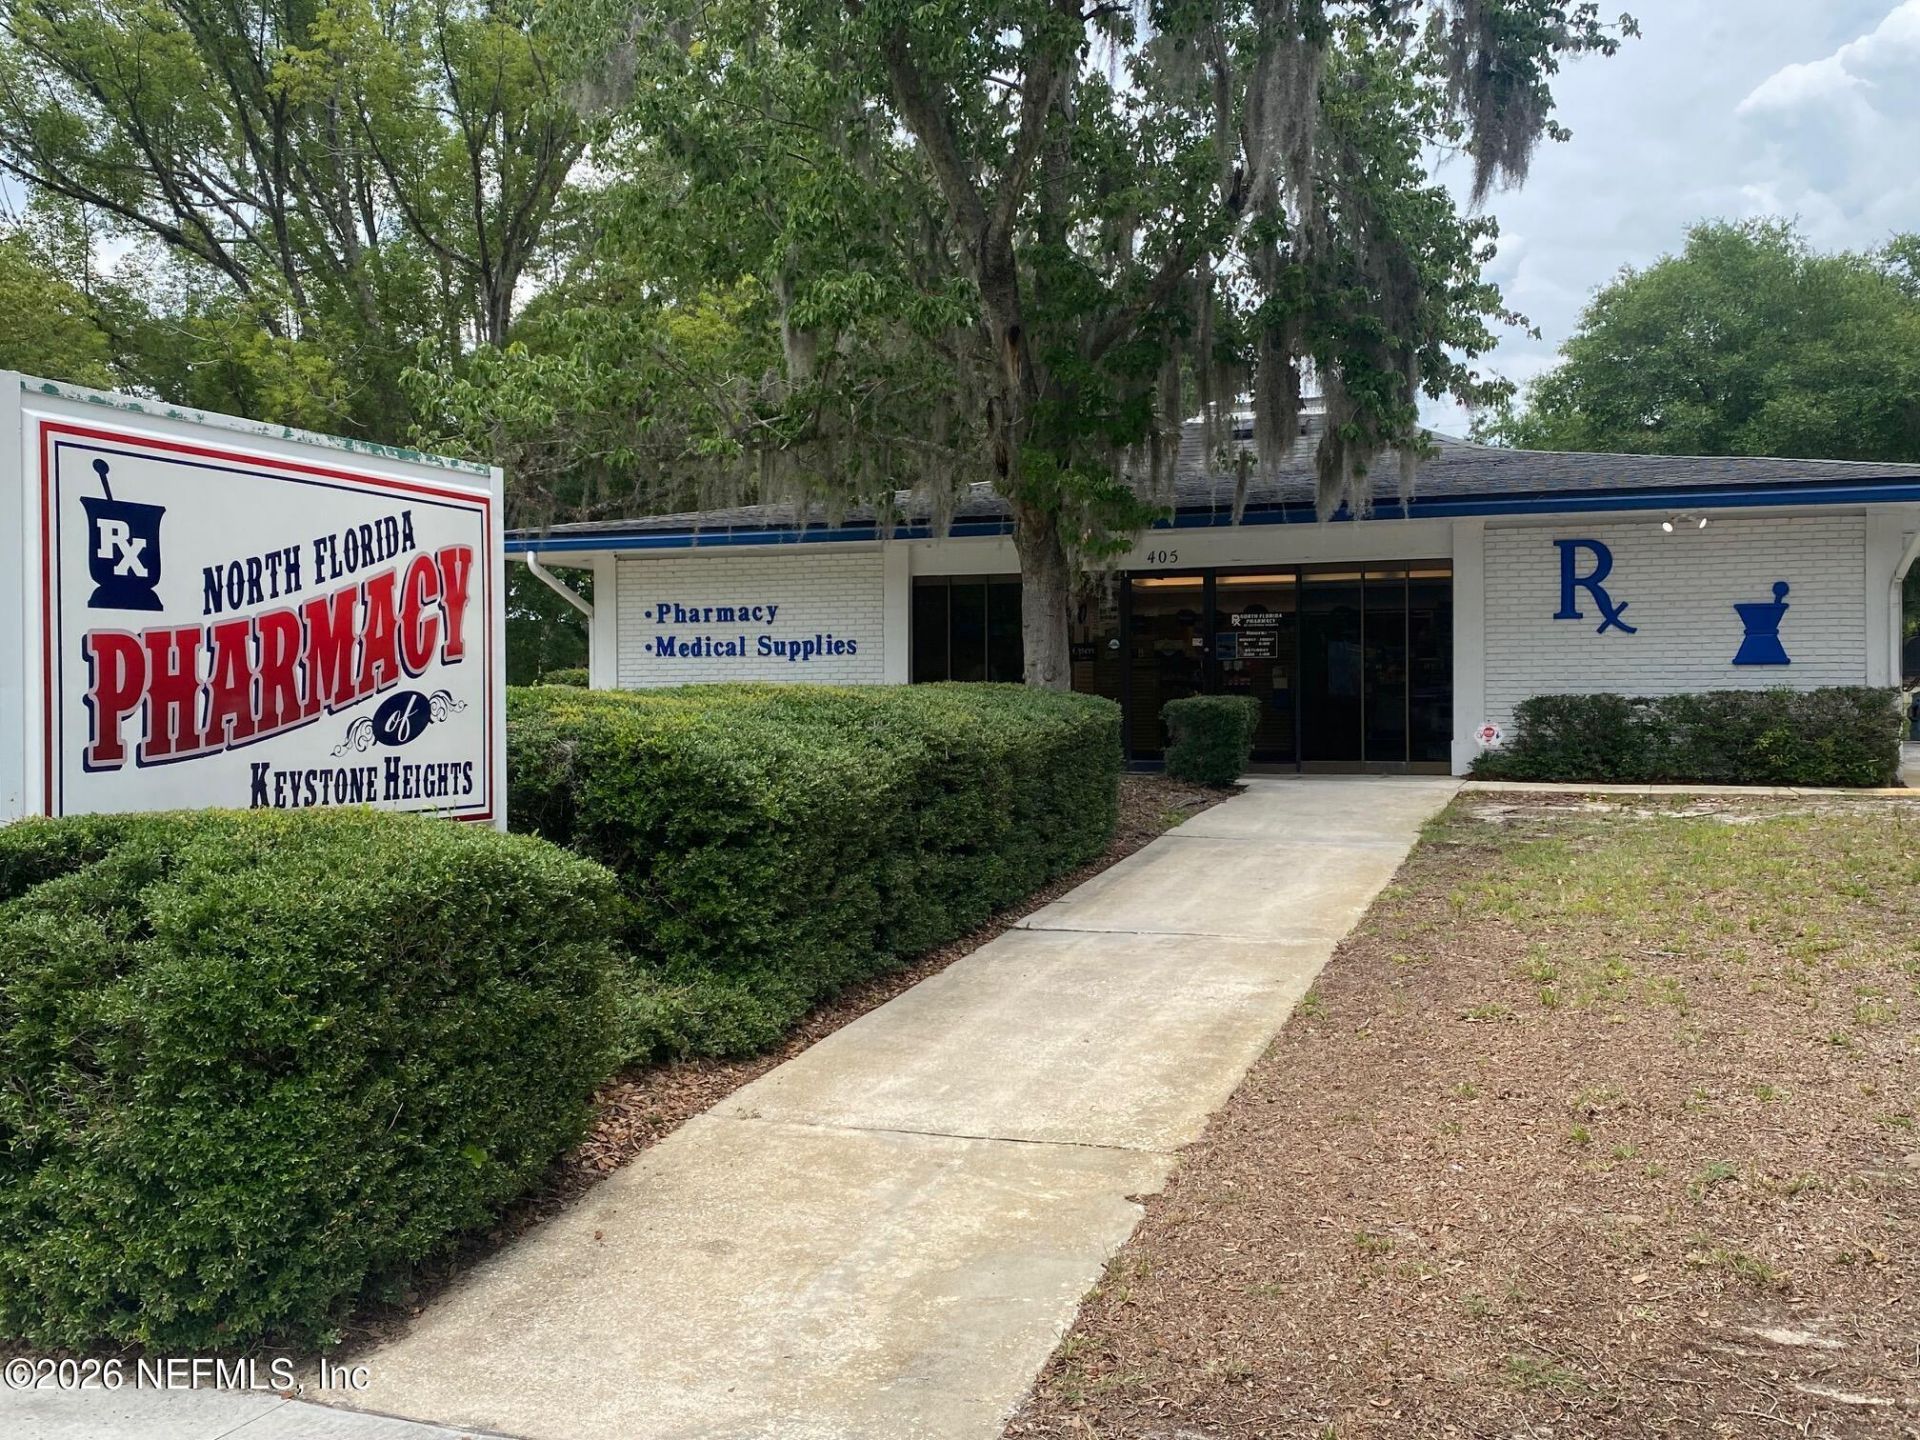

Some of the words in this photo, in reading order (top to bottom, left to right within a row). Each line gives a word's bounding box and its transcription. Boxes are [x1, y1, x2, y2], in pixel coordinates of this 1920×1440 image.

[202, 544, 302, 616] NORTH
[313, 510, 416, 585] FLORIDA
[1147, 550, 1179, 564] 405
[656, 603, 779, 625] Pharmacy
[82, 544, 474, 773] PHARMACY
[655, 635, 747, 657] Medical
[757, 634, 857, 661] Supplies
[385, 690, 418, 743] of
[249, 762, 378, 810] KEYSTONE
[384, 756, 474, 803] HEIGHTS
